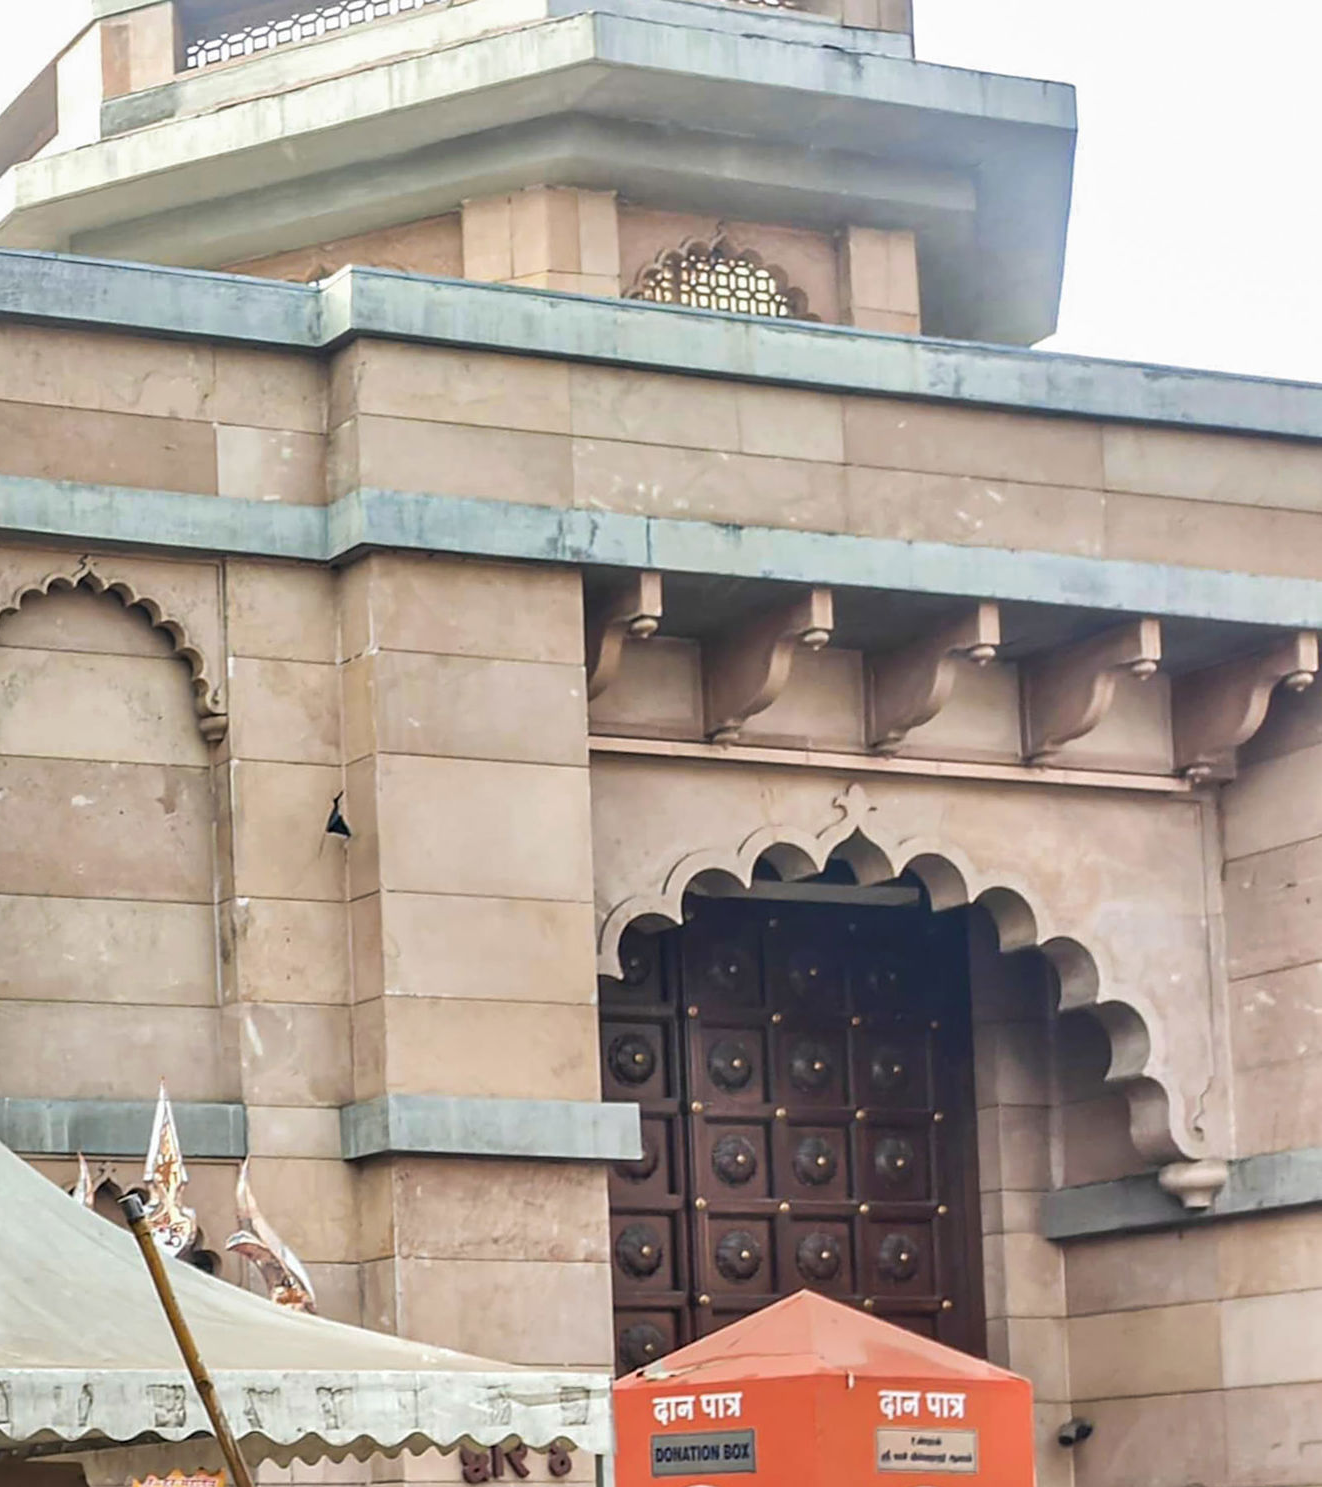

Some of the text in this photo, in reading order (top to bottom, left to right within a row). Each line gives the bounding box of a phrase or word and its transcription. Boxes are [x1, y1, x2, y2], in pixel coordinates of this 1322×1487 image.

[652, 1391, 742, 1425] दान पात्र
[877, 1389, 966, 1421] दान पात्र
[654, 1441, 749, 1462] DONATION BOX
